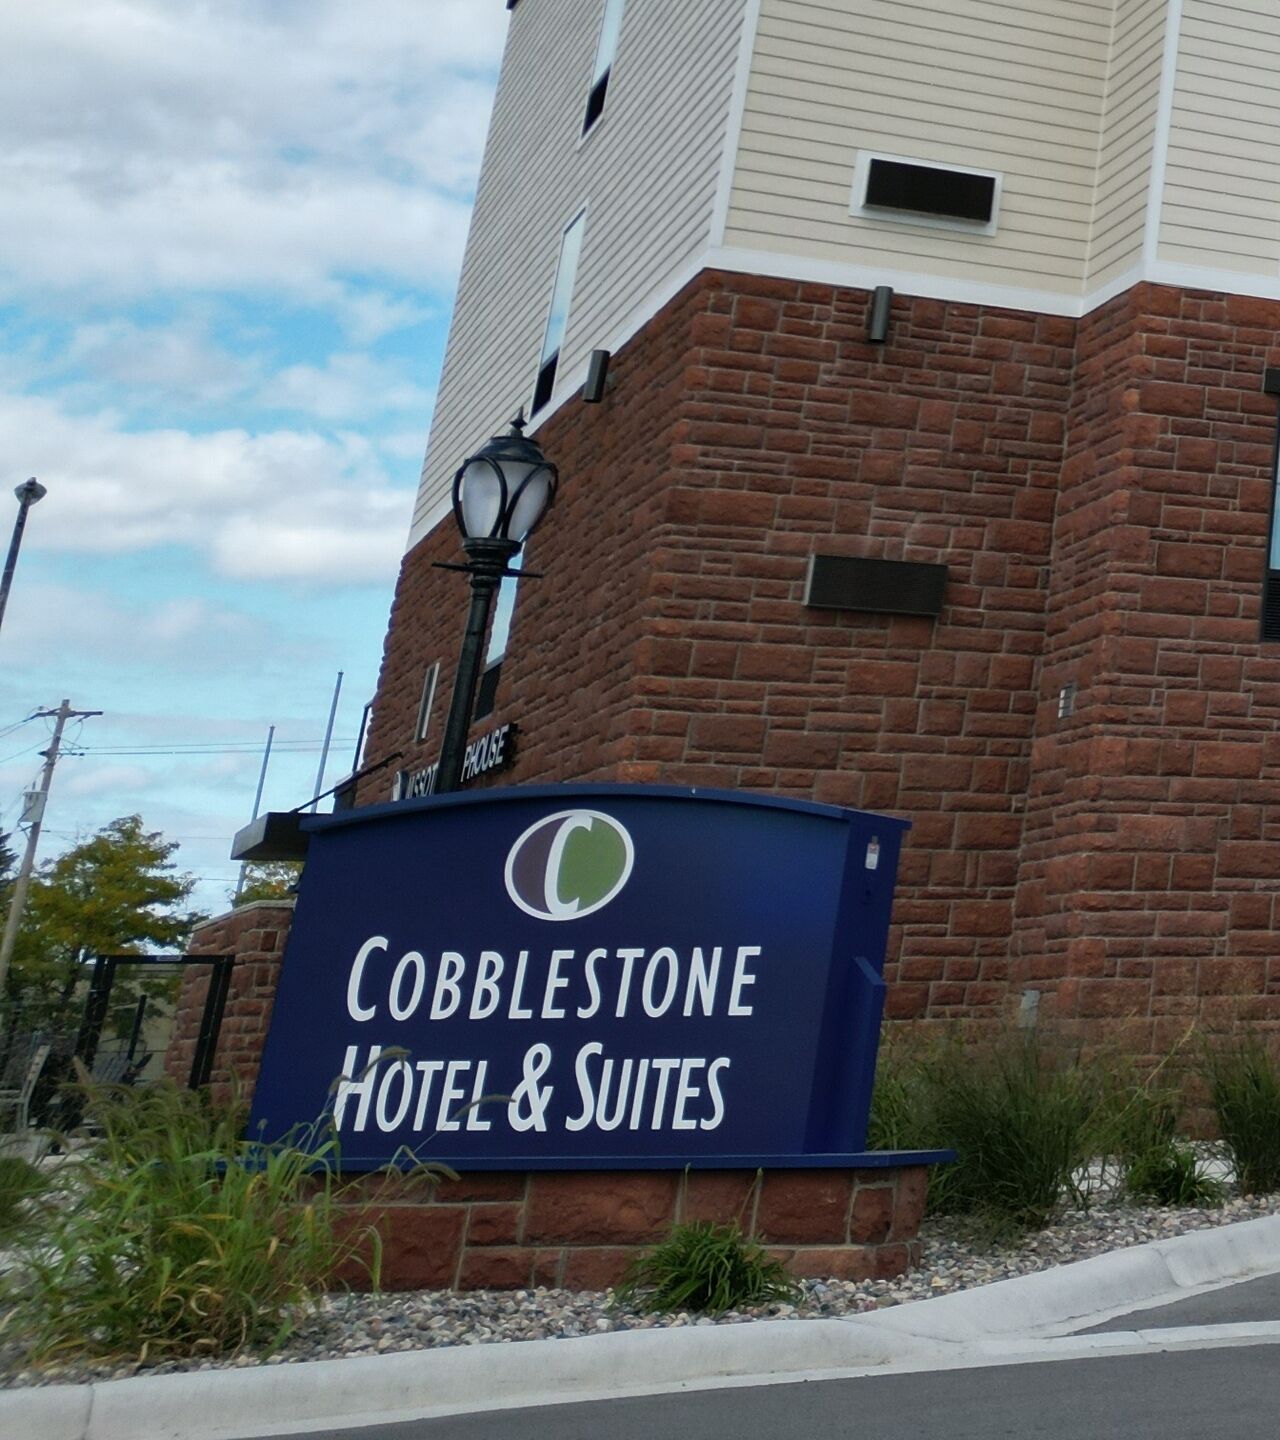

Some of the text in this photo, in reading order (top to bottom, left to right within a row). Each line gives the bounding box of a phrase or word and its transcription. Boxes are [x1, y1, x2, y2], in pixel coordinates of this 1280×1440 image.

[347, 935, 762, 1022] COBBLESTONE
[335, 1041, 731, 1132] HOTEL & SUITES
